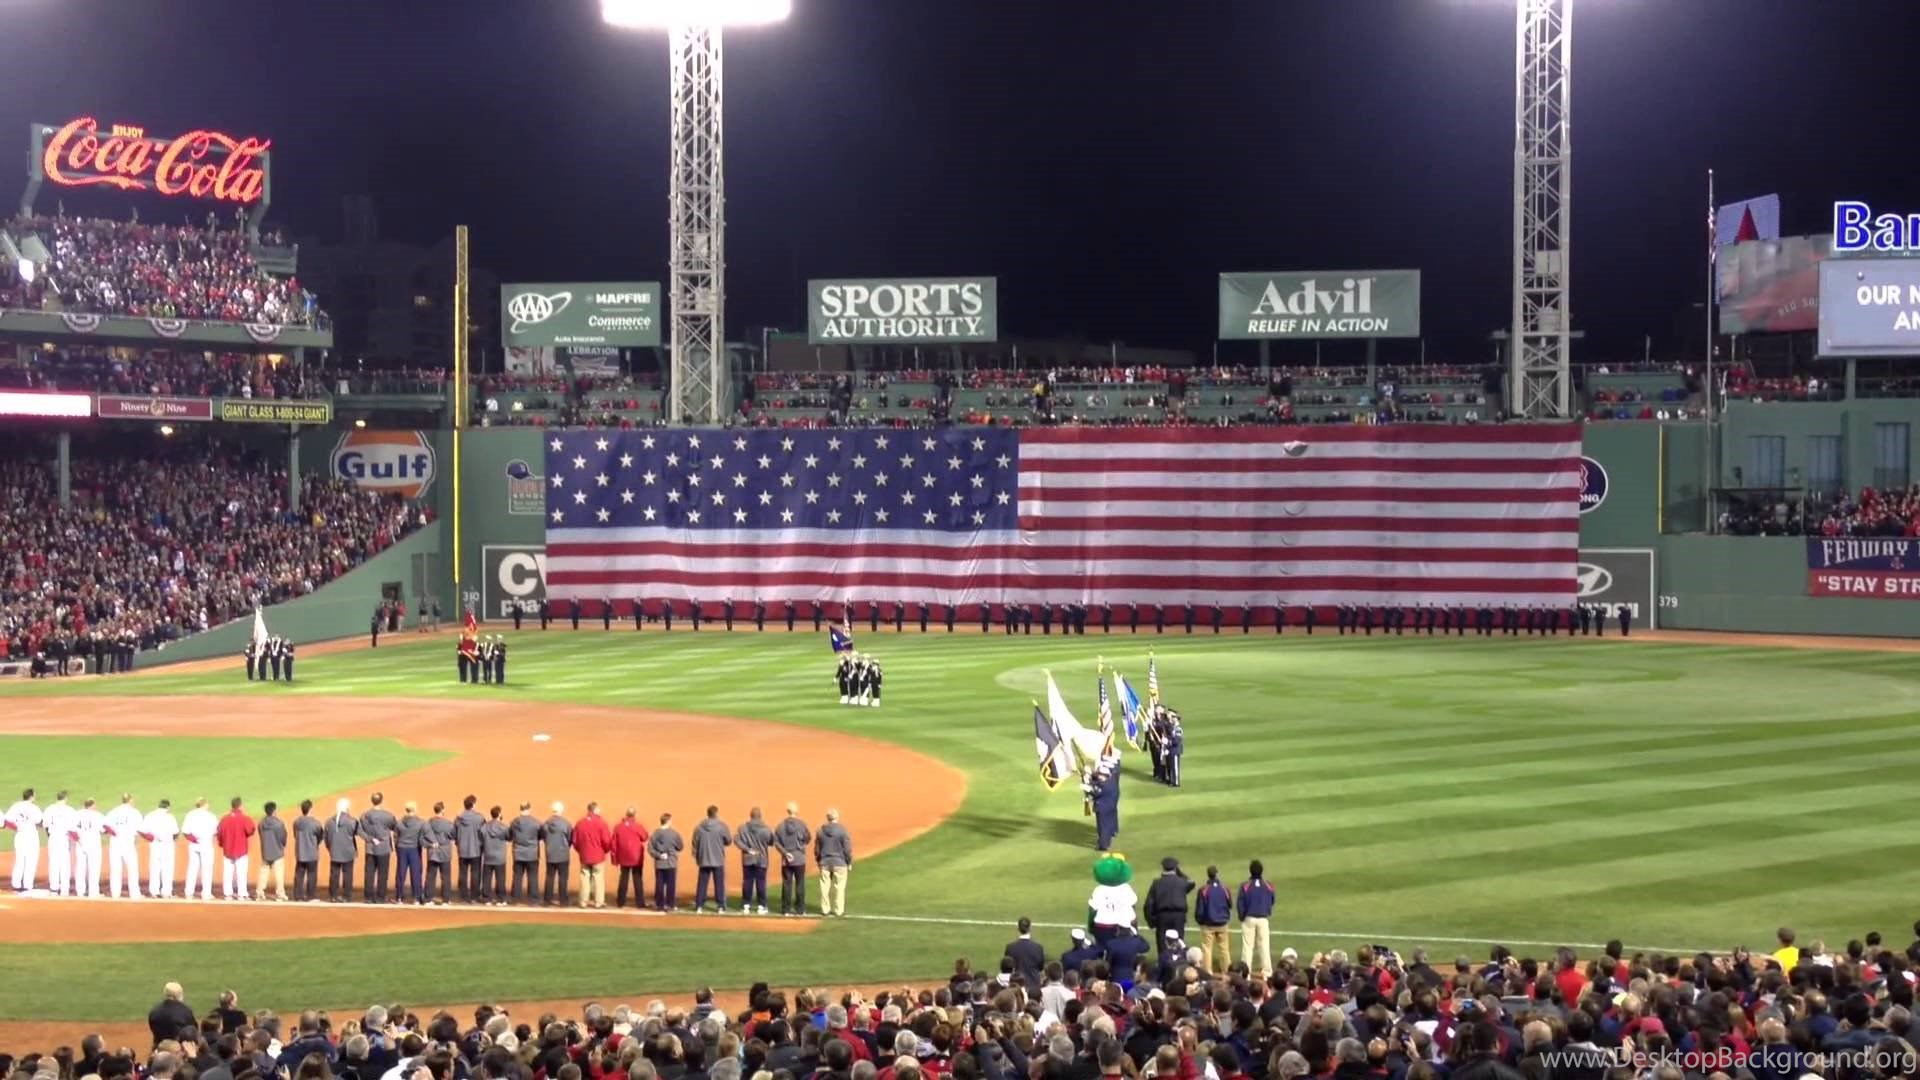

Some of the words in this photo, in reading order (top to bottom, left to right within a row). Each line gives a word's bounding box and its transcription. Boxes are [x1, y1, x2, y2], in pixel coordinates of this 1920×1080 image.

[112, 124, 143, 138] ENJOY
[595, 293, 651, 305] MAPFRE
[821, 283, 983, 317] SPORTS
[1251, 277, 1372, 315] Advil
[1856, 285, 1901, 305] OUR
[513, 294, 548, 323] AAA
[588, 315, 652, 327] Commerce
[821, 316, 982, 338] AUTHORITY
[1247, 318, 1297, 333] RELIEF
[1301, 318, 1321, 332] IN
[1325, 318, 1389, 332] ACTION
[166, 404, 187, 413] Nine
[224, 404, 247, 417] GIANT
[249, 405, 274, 418] GLASS
[338, 452, 428, 478] Gulf
[1822, 539, 1909, 568] FENWAY
[463, 591, 480, 602] 310
[1658, 595, 1679, 608] 379
